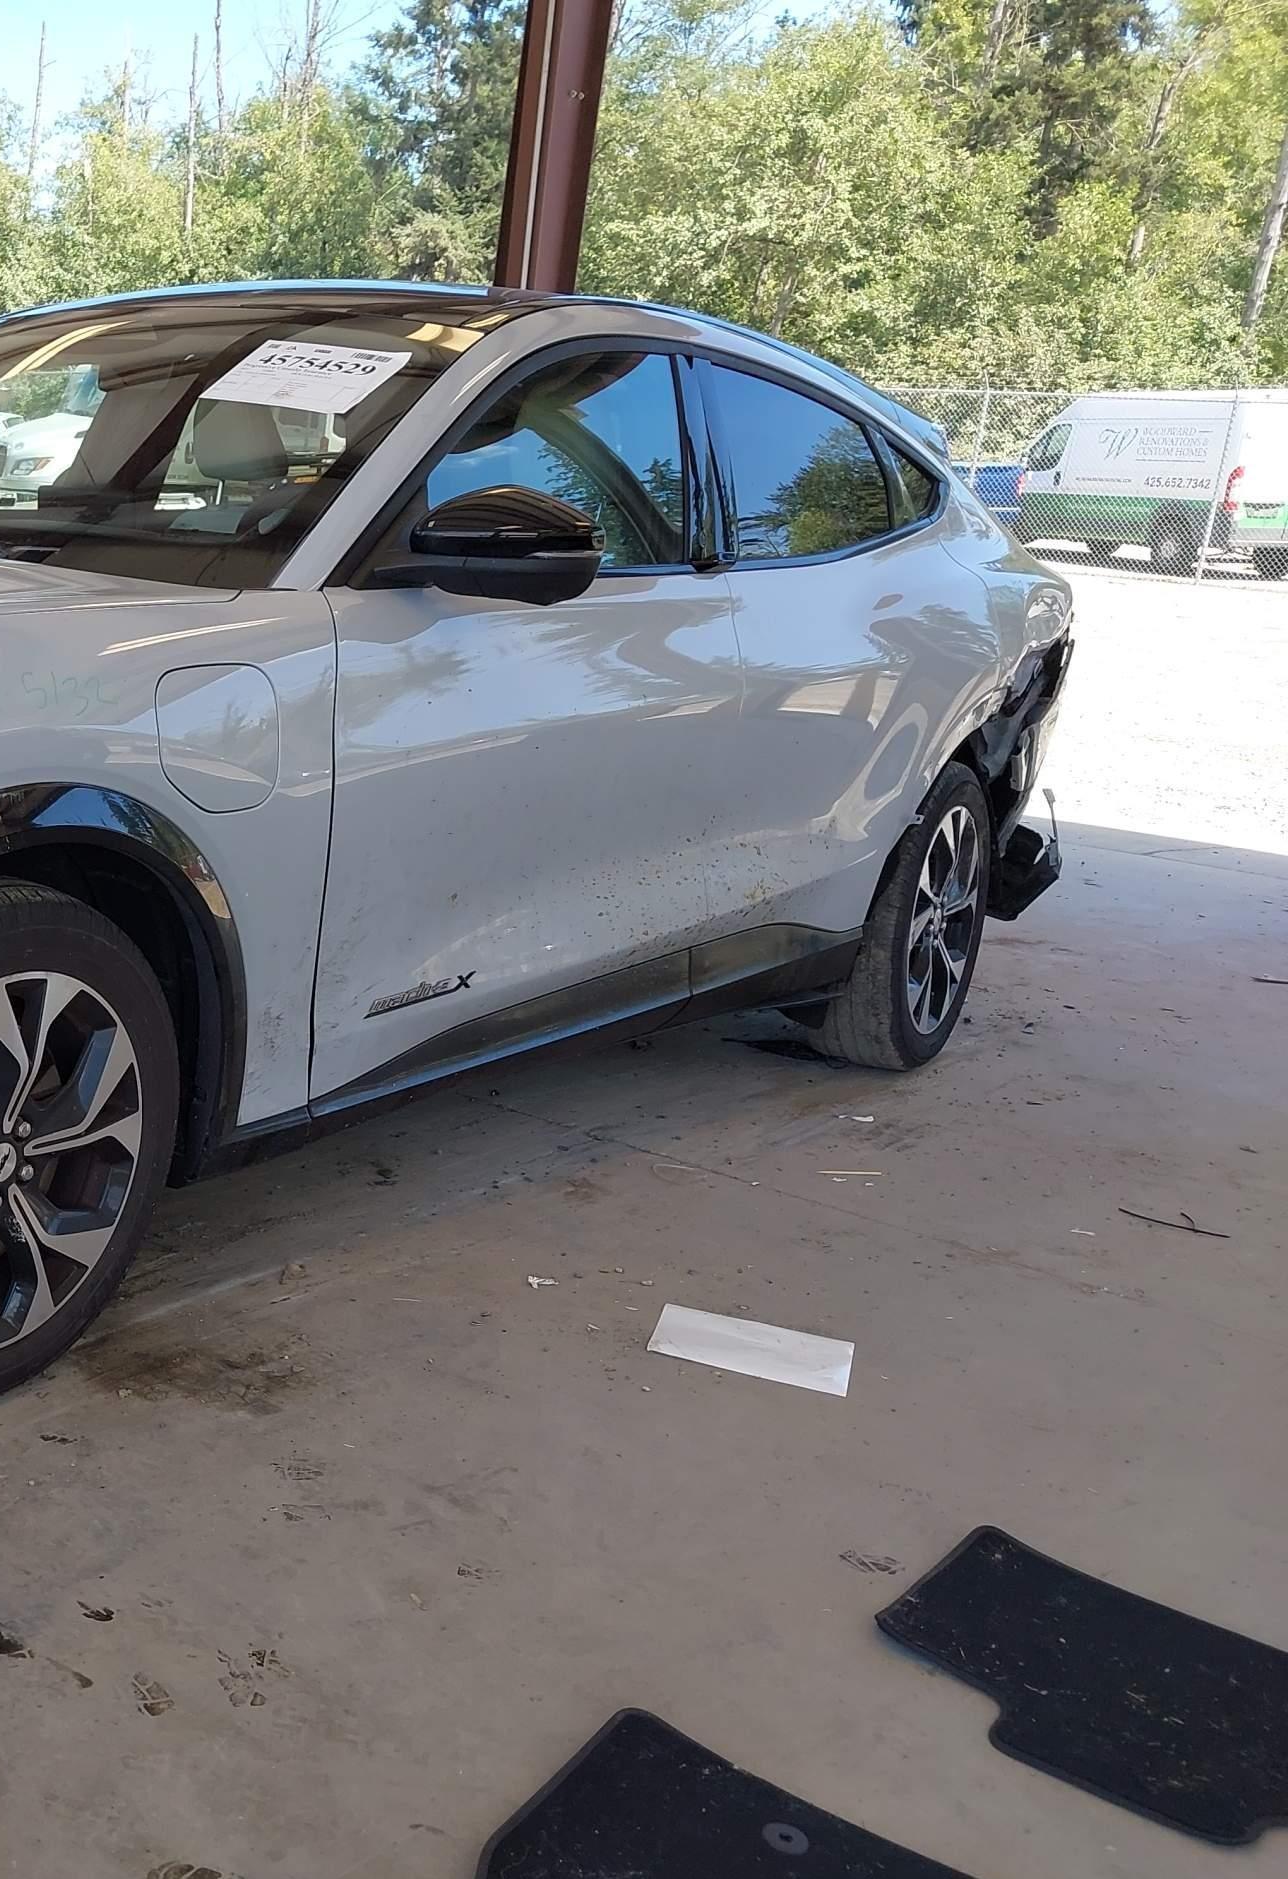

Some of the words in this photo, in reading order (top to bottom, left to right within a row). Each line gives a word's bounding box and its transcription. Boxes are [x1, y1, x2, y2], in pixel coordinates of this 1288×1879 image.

[259, 353, 376, 376] 45754529
[1136, 446, 1173, 457] CUSTOM
[1175, 447, 1208, 457] HOMES
[1143, 476, 1211, 490] 425.652.7342
